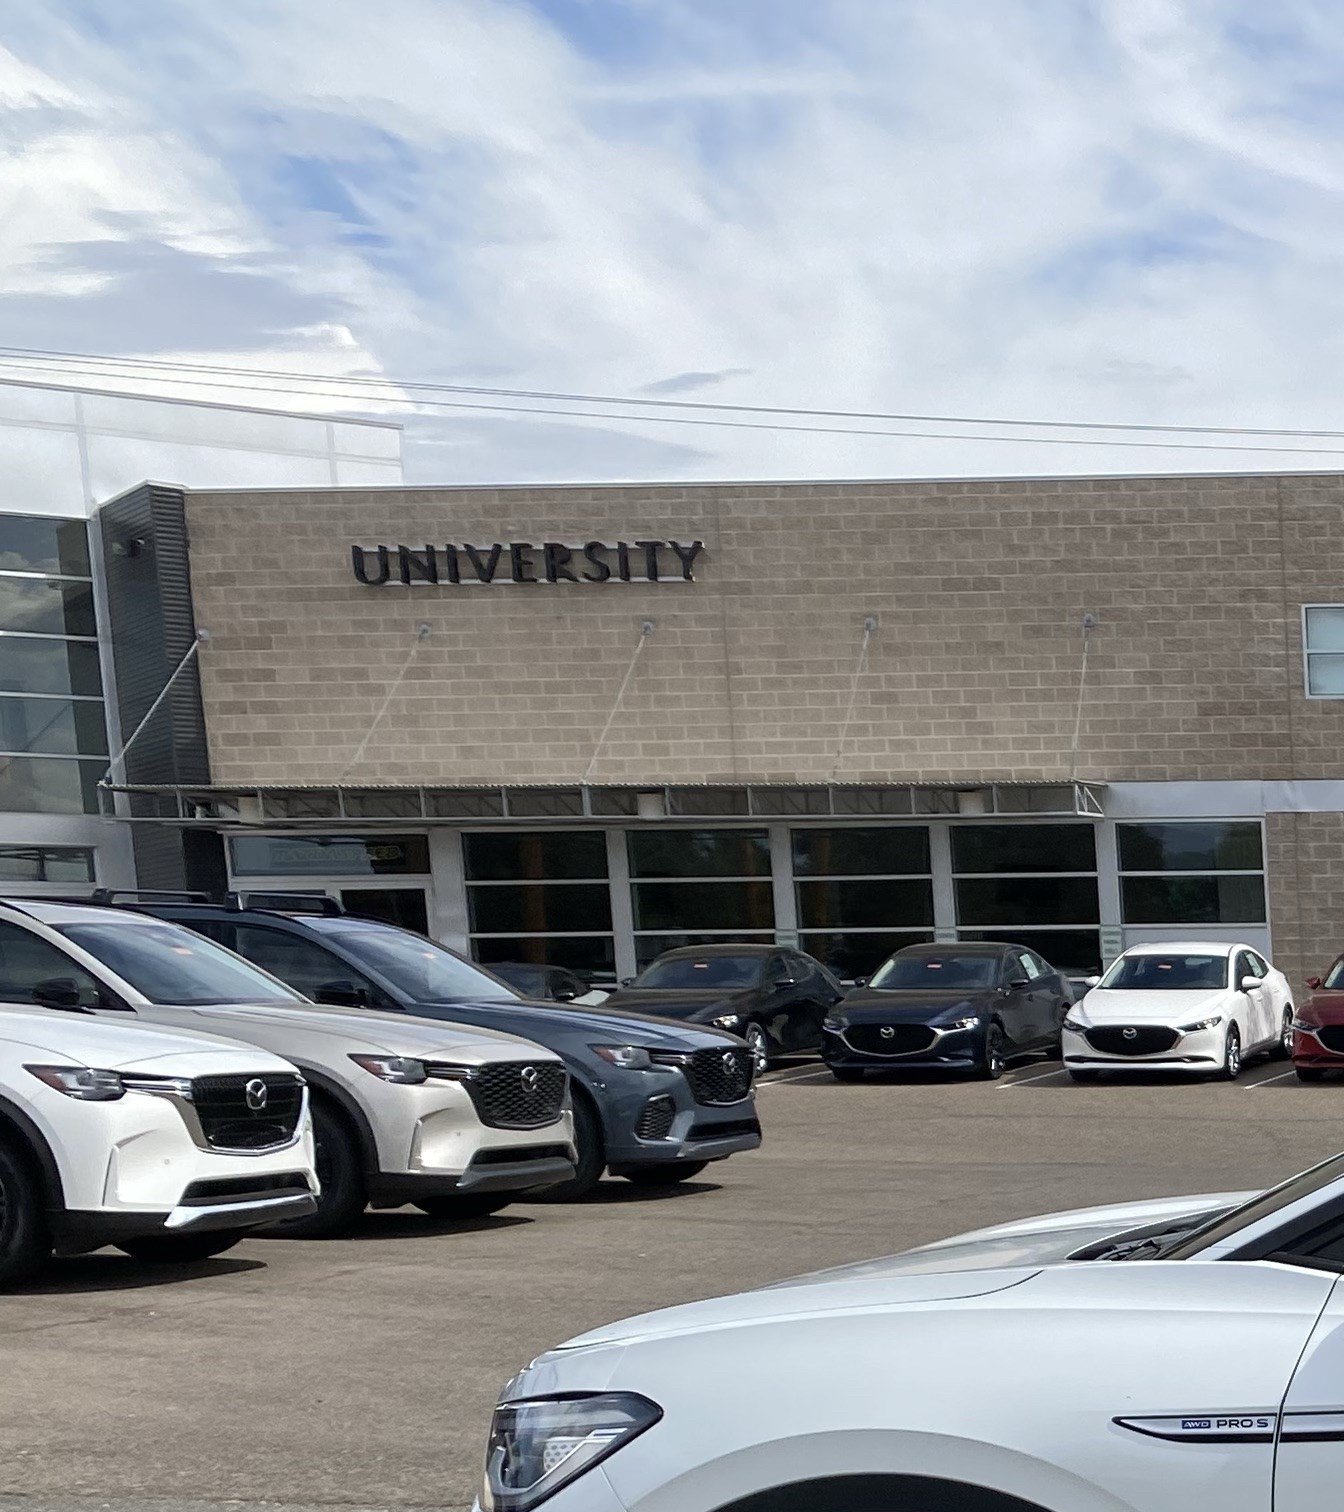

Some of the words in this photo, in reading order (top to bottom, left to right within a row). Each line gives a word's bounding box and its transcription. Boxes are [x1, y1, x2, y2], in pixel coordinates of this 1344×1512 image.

[352, 540, 704, 586] UNIVERSITY
[1216, 1419, 1253, 1428] PRO
[1256, 1418, 1269, 1428] S
